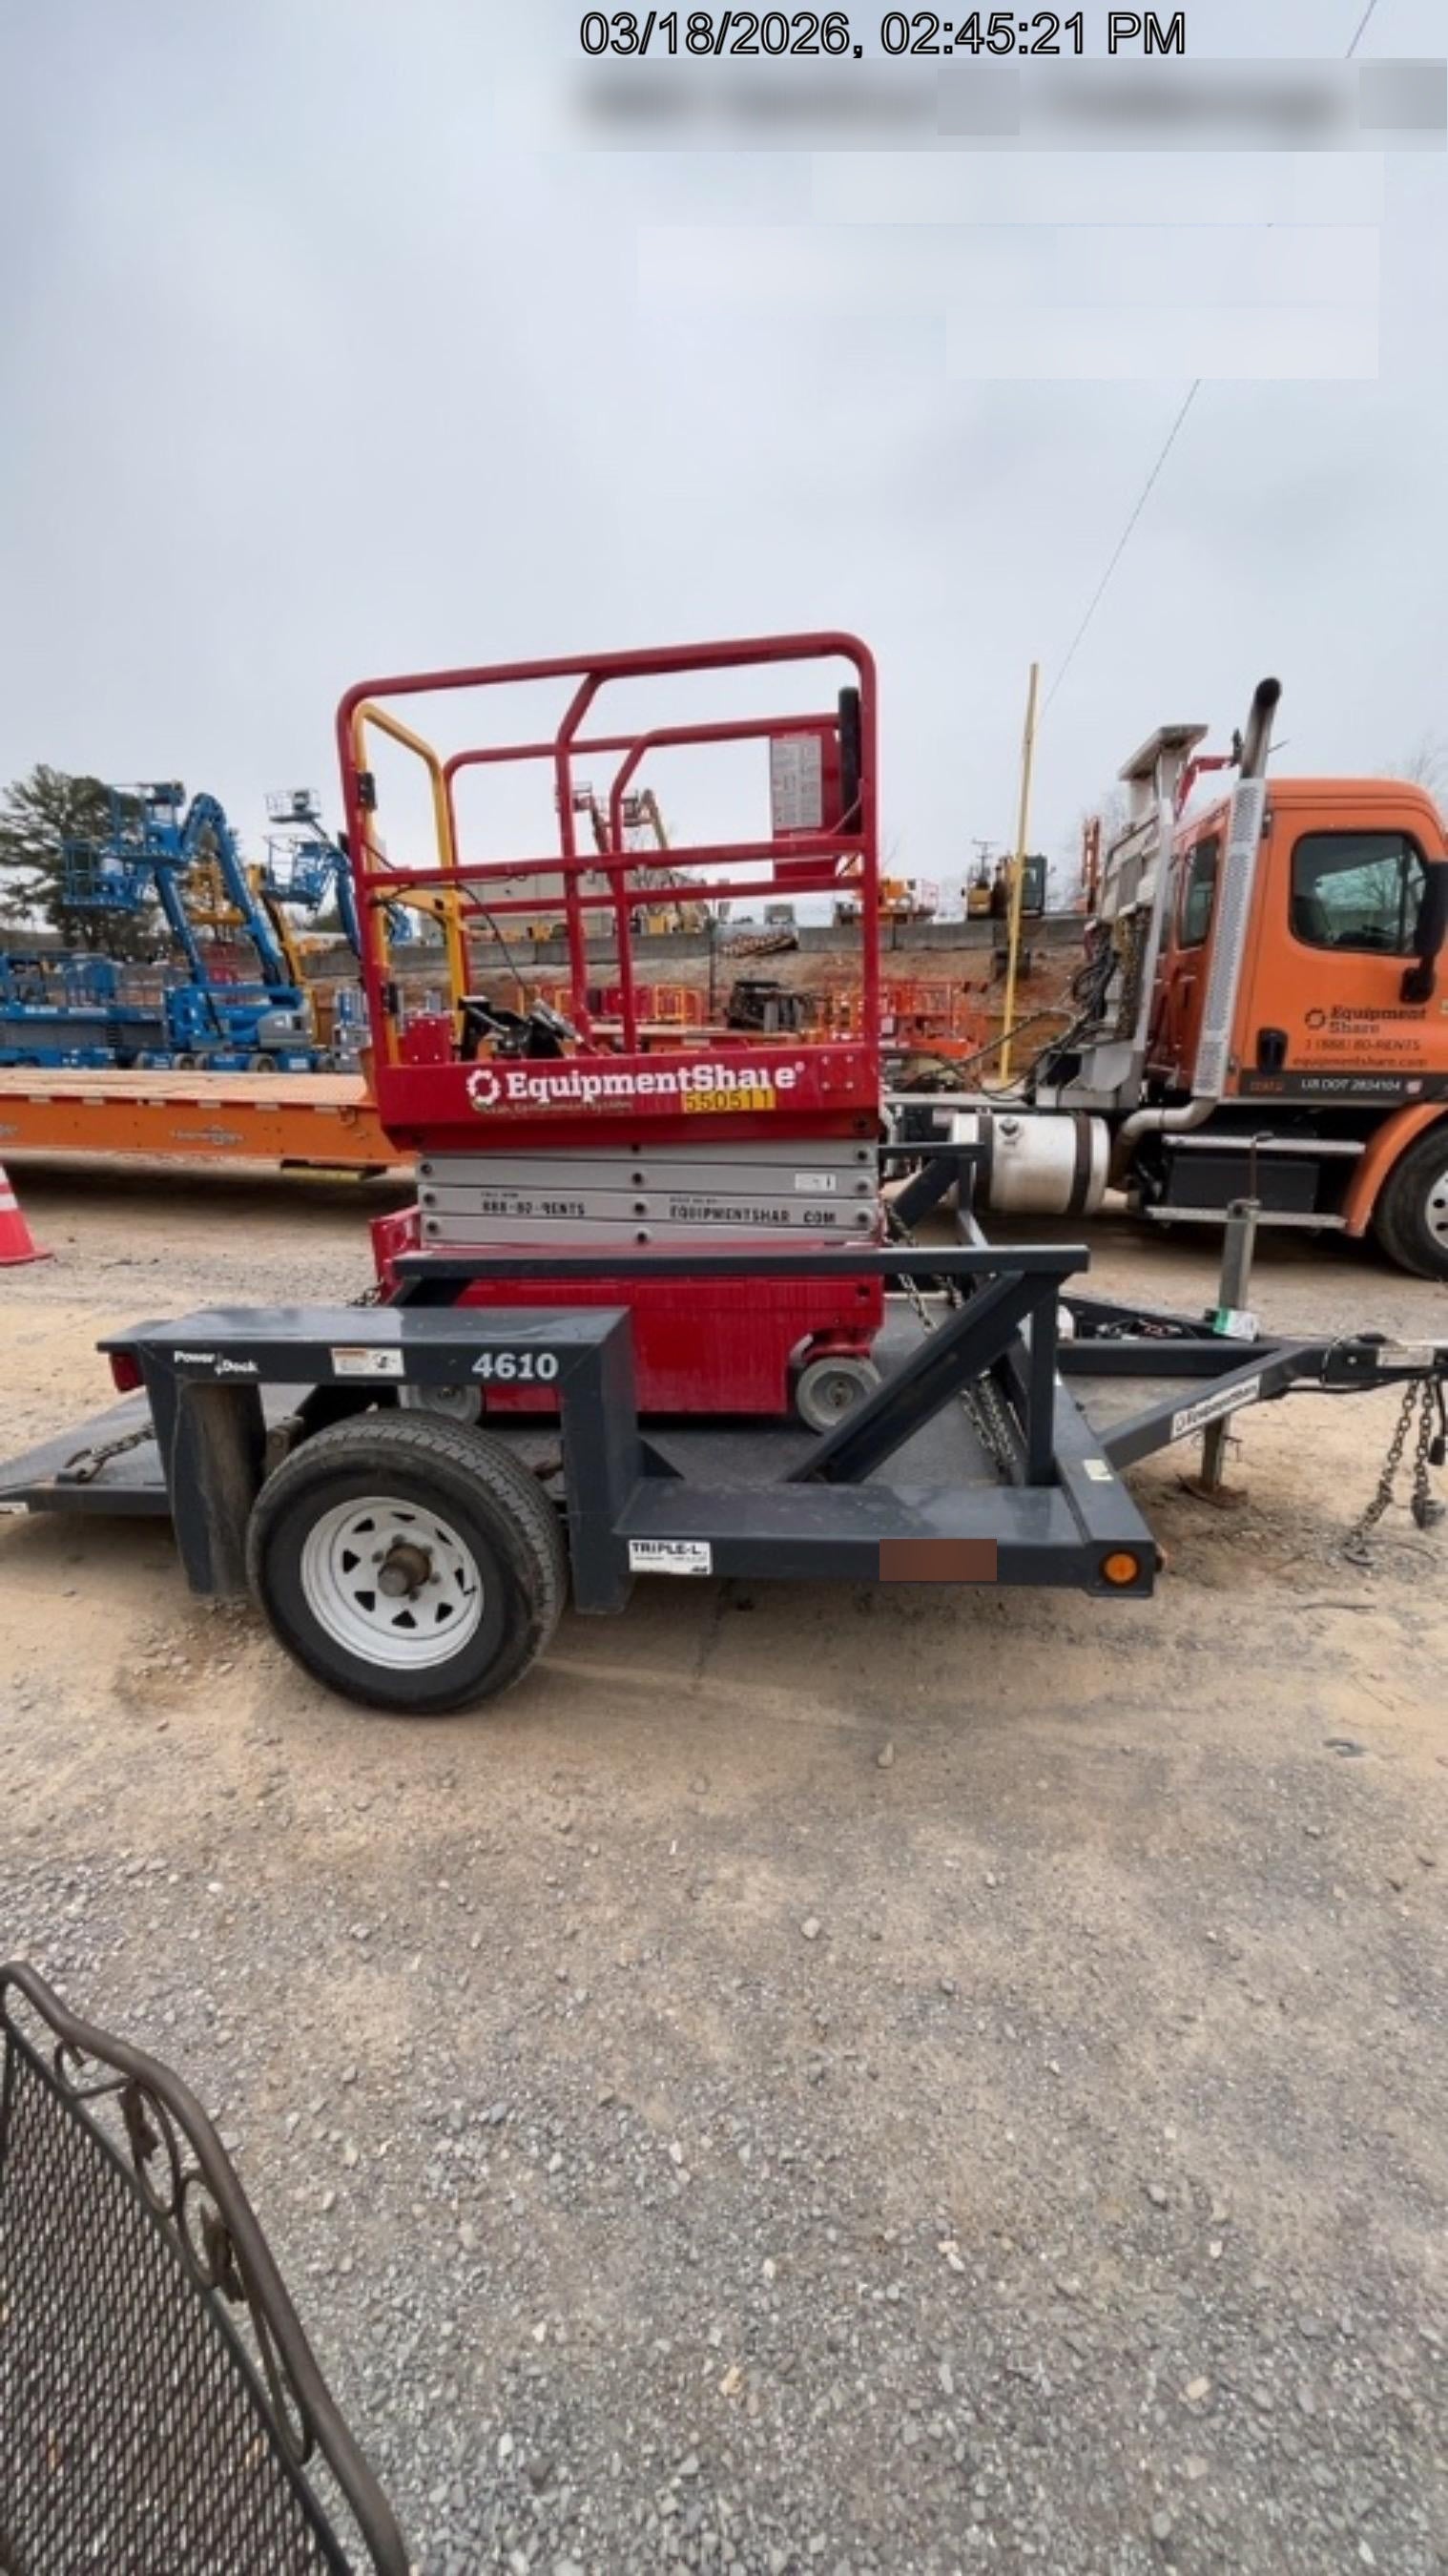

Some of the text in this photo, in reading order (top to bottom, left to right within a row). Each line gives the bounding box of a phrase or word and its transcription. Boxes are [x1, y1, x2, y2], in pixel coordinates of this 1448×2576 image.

[1330, 1005, 1426, 1021] Equipment
[1329, 1020, 1379, 1033] Share
[686, 1090, 769, 1111] 550511
[471, 1352, 559, 1379] 4610
[631, 1542, 702, 1555] TRIPLE-L
